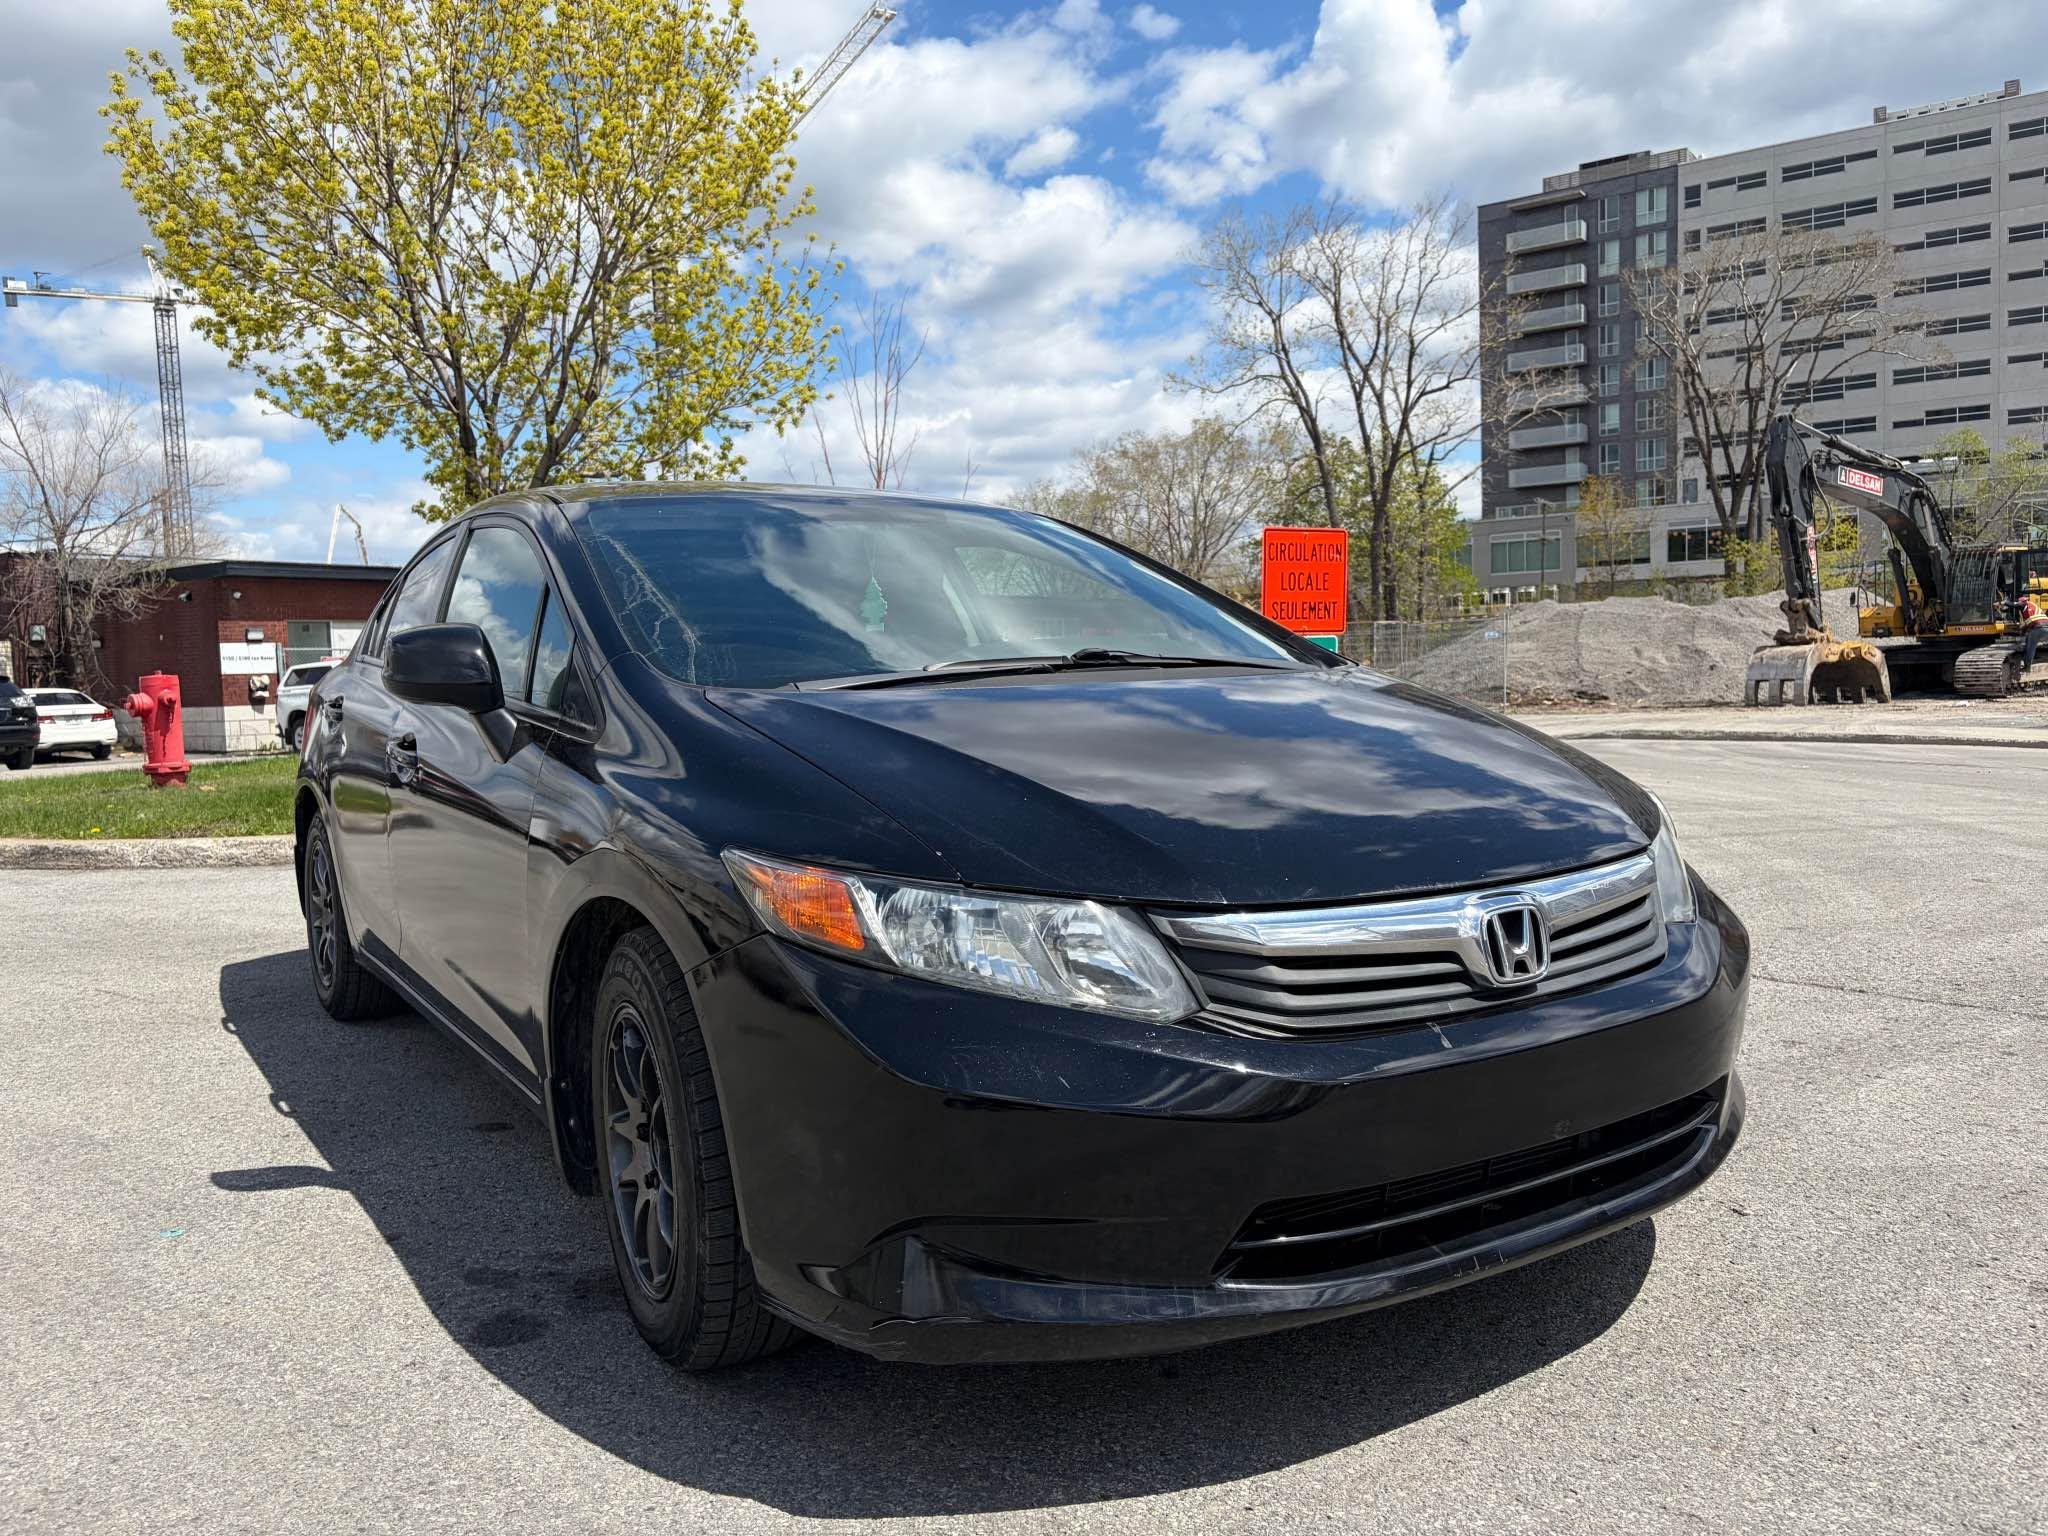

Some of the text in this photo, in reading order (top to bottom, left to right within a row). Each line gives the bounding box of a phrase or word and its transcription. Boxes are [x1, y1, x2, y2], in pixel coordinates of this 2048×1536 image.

[1849, 471, 1881, 491] DELSAN
[1268, 543, 1342, 562] CIRCULATION
[1281, 572, 1329, 591] LOCALE
[1272, 602, 1338, 620] SEULEMENT
